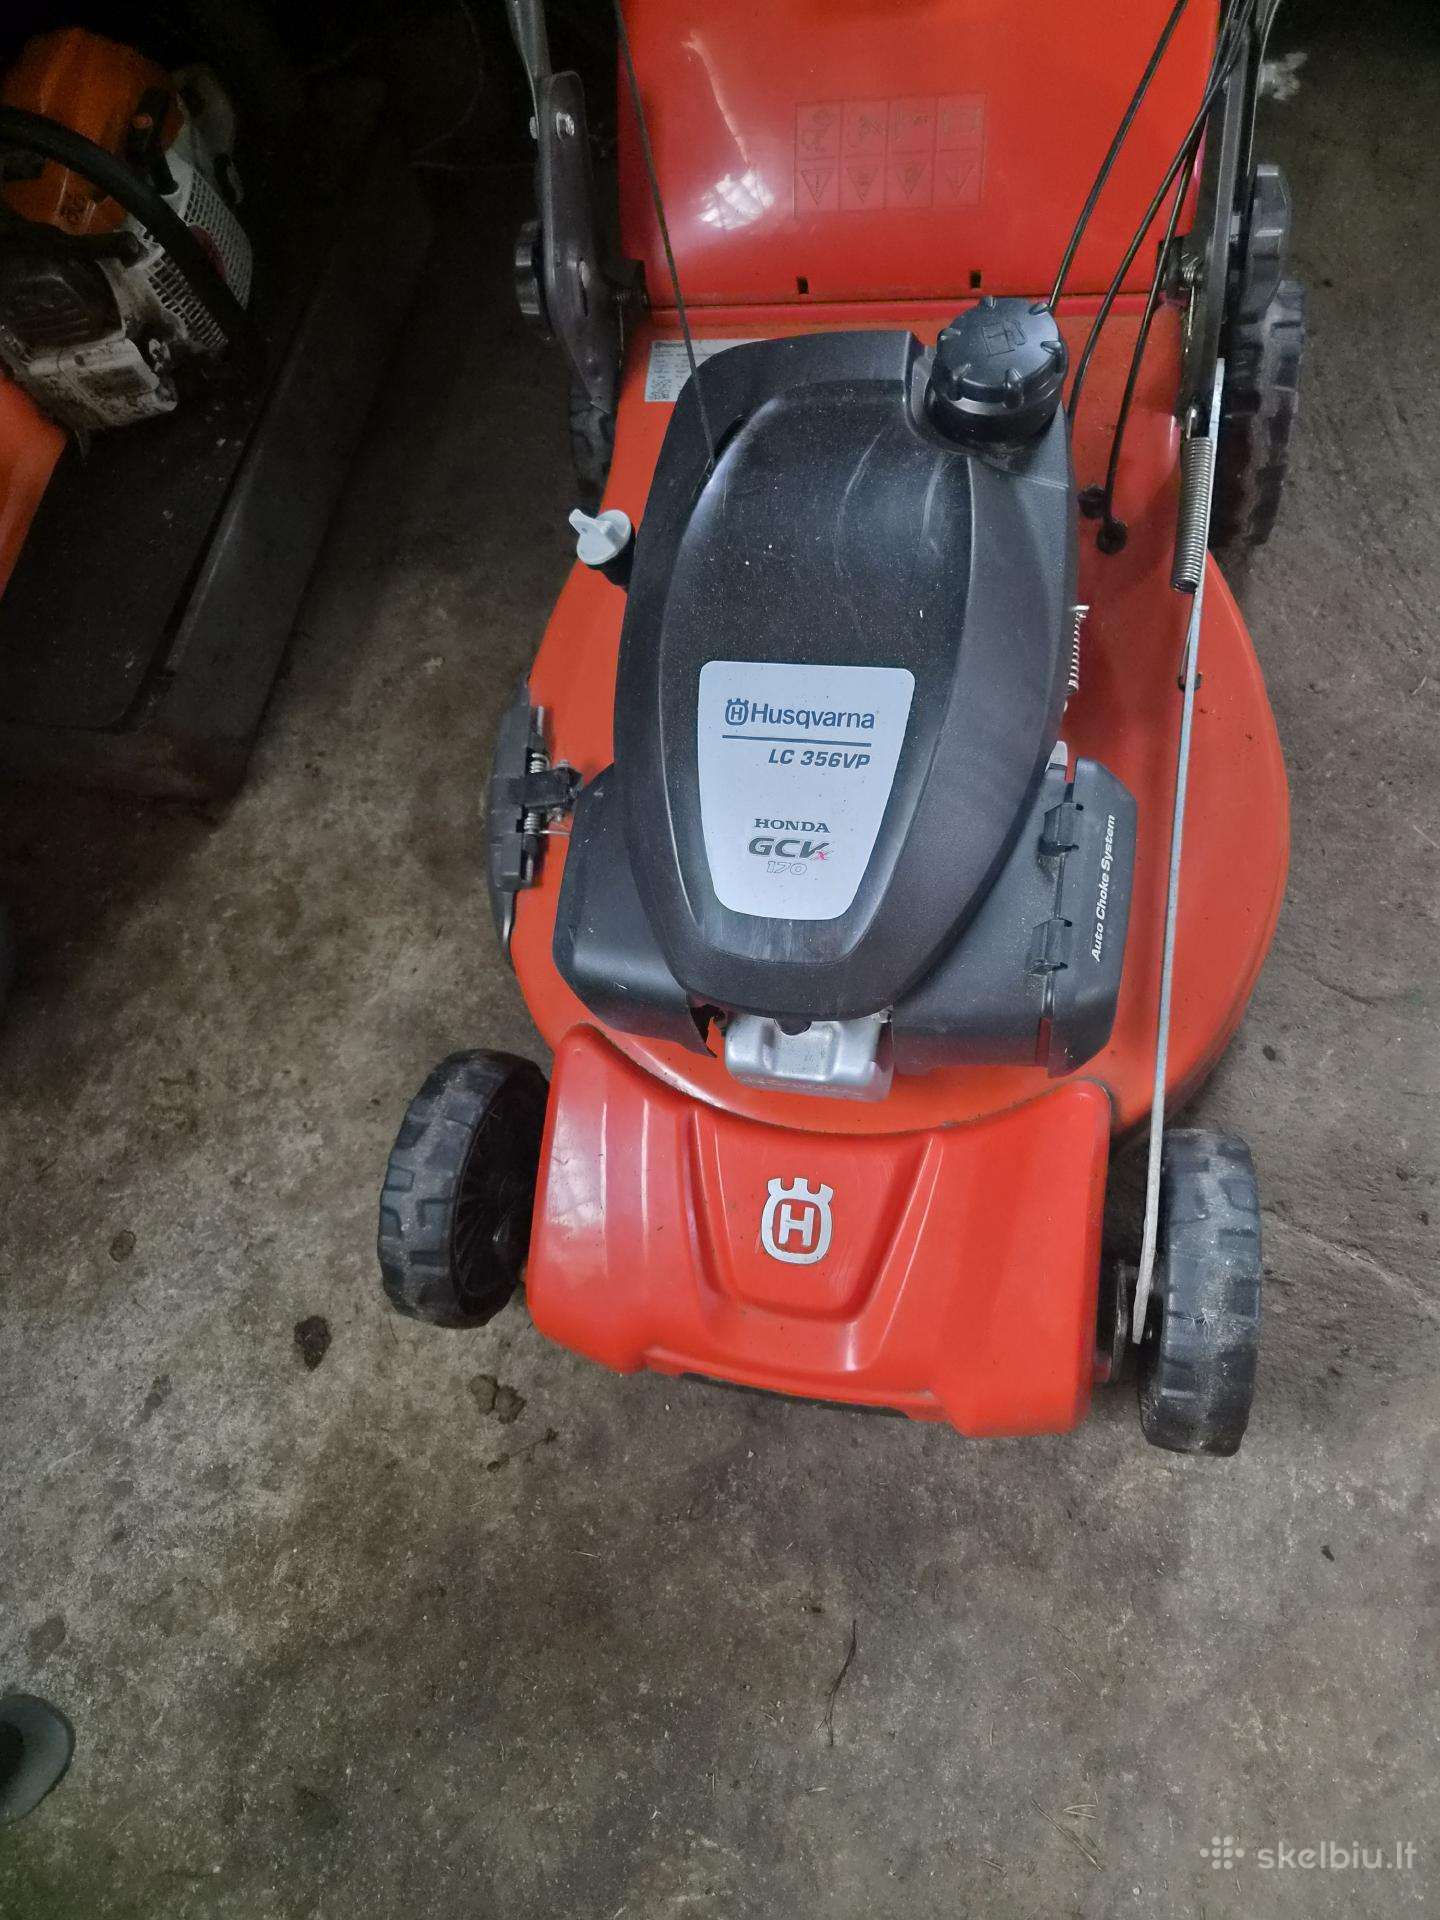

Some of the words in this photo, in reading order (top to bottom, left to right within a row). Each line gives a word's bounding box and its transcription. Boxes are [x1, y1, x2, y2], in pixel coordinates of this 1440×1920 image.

[751, 703, 875, 729] Husqvarna
[768, 749, 795, 765] LC
[800, 750, 871, 769] 356VP
[754, 818, 831, 833] HONDA
[1101, 814, 1116, 872] System
[766, 861, 807, 875] 170
[1096, 873, 1110, 920] Choke
[1091, 922, 1104, 962] Auto
